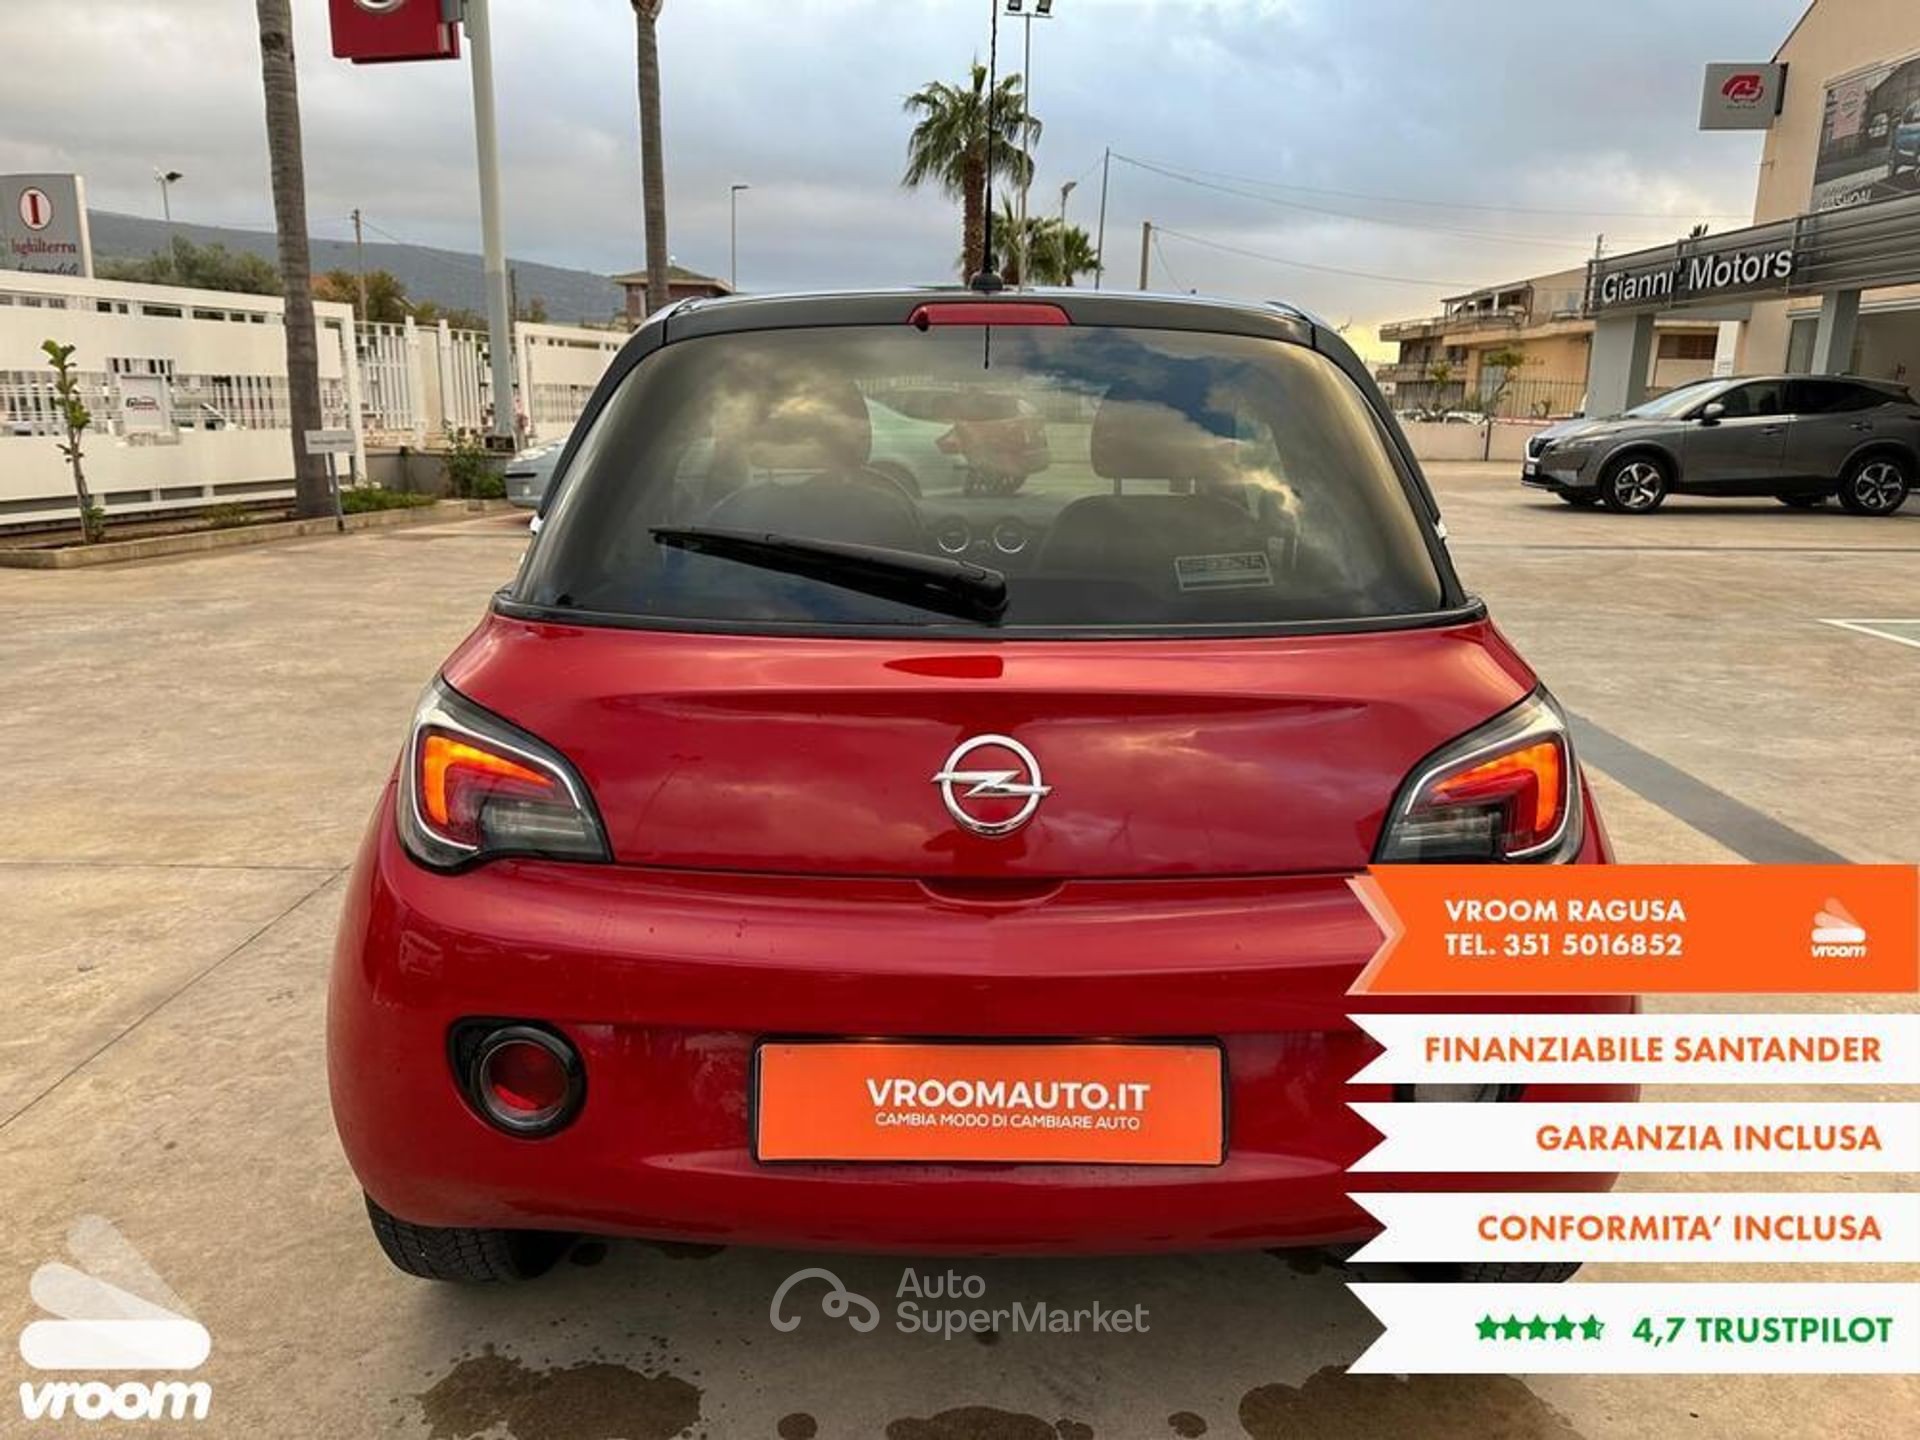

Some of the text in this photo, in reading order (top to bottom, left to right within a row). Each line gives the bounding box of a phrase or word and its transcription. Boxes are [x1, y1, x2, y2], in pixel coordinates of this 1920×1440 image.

[1689, 250, 1793, 291] Motors
[867, 1078, 1150, 1111] VROOMAUTO.IT
[875, 1111, 1140, 1130] CAMBIA MODO DI CAMBIARE AUTO
